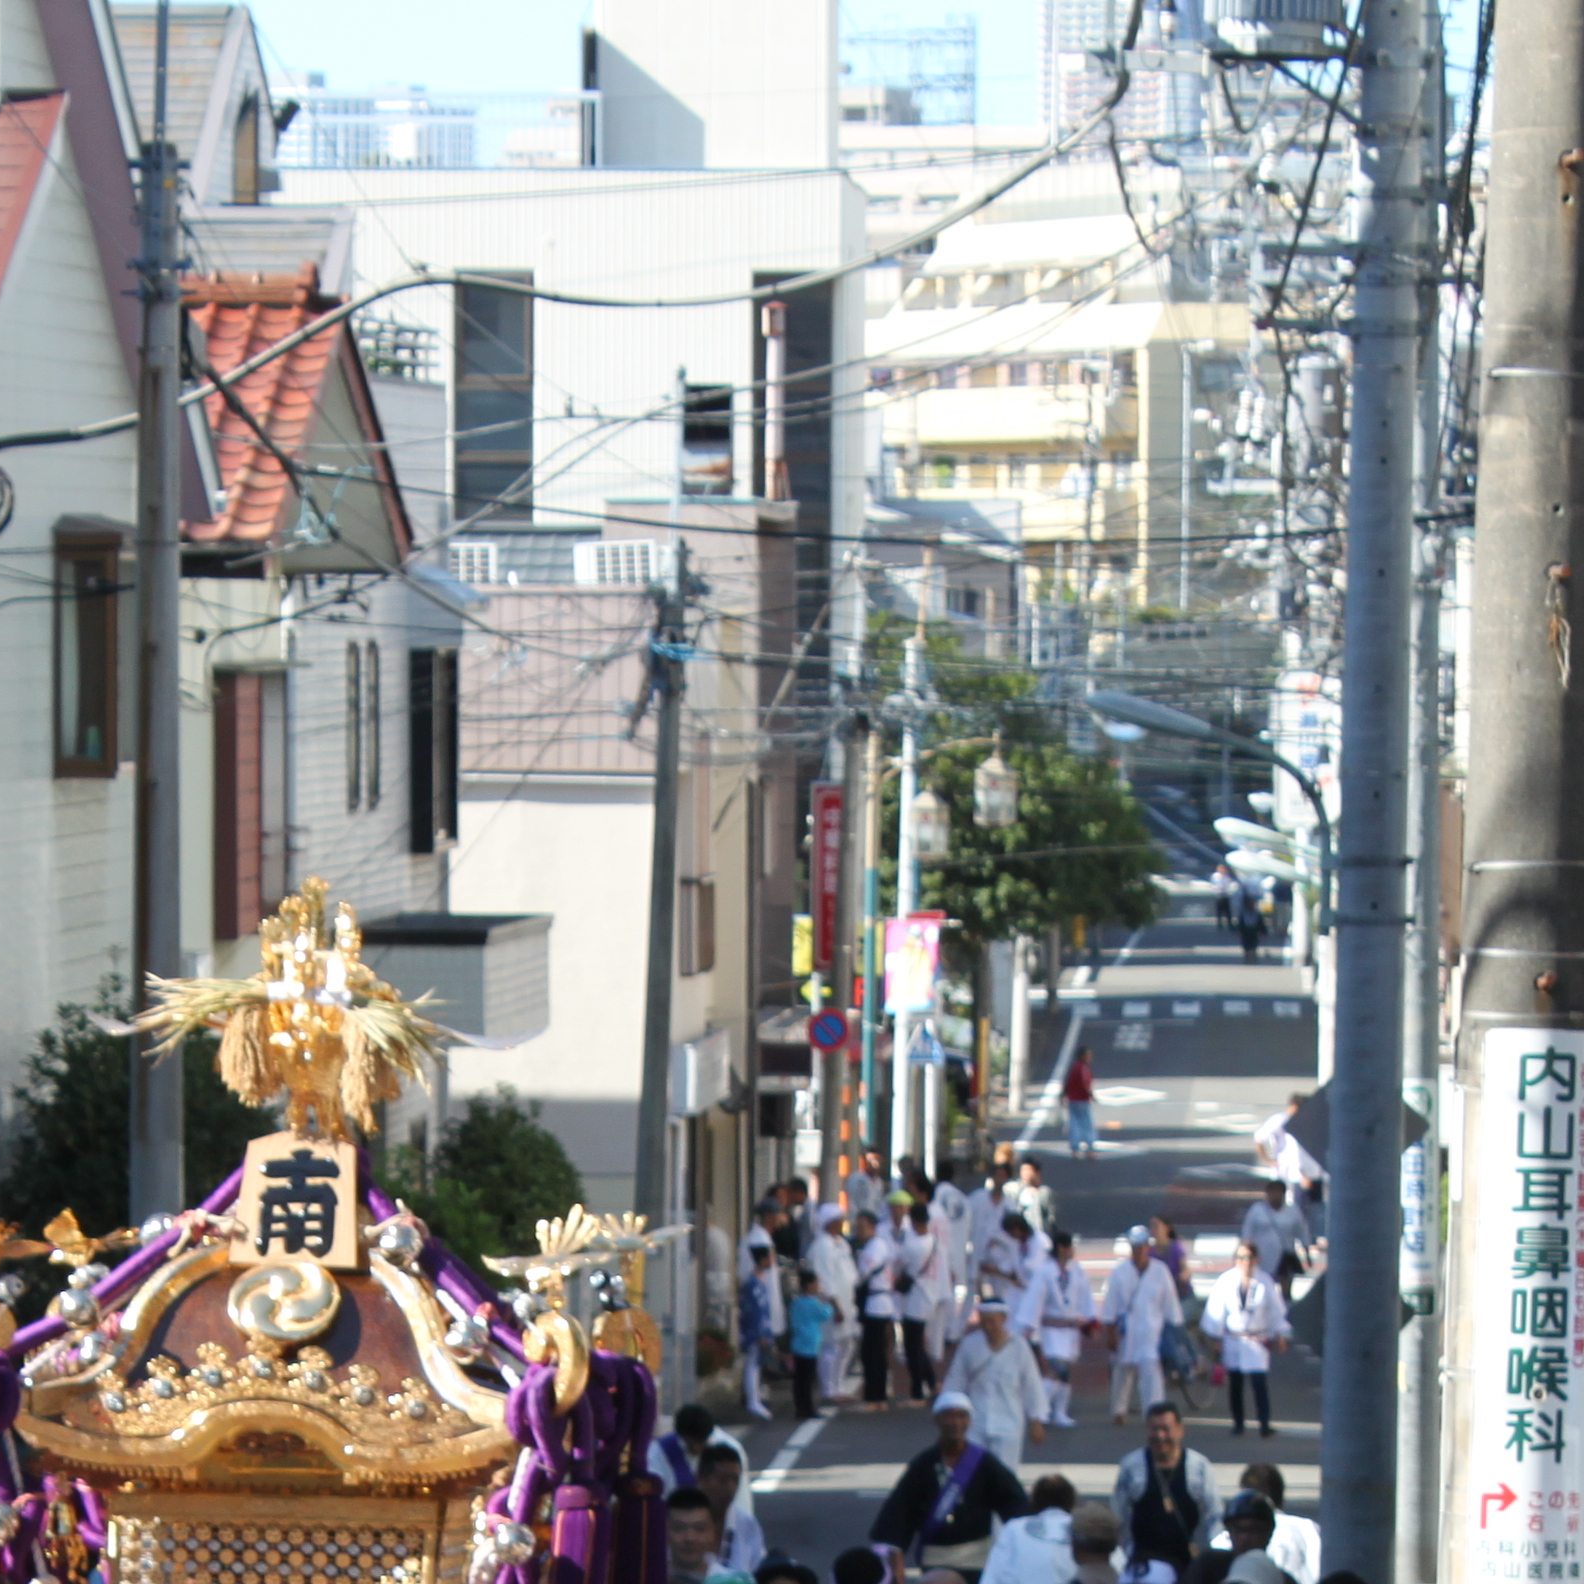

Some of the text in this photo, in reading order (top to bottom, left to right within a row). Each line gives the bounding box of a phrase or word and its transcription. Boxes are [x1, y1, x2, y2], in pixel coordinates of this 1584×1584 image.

[255, 1149, 340, 1257] 南
[1505, 1046, 1577, 1464] 内山耳鼻咽喉科
[1528, 1490, 1581, 1511] この先
